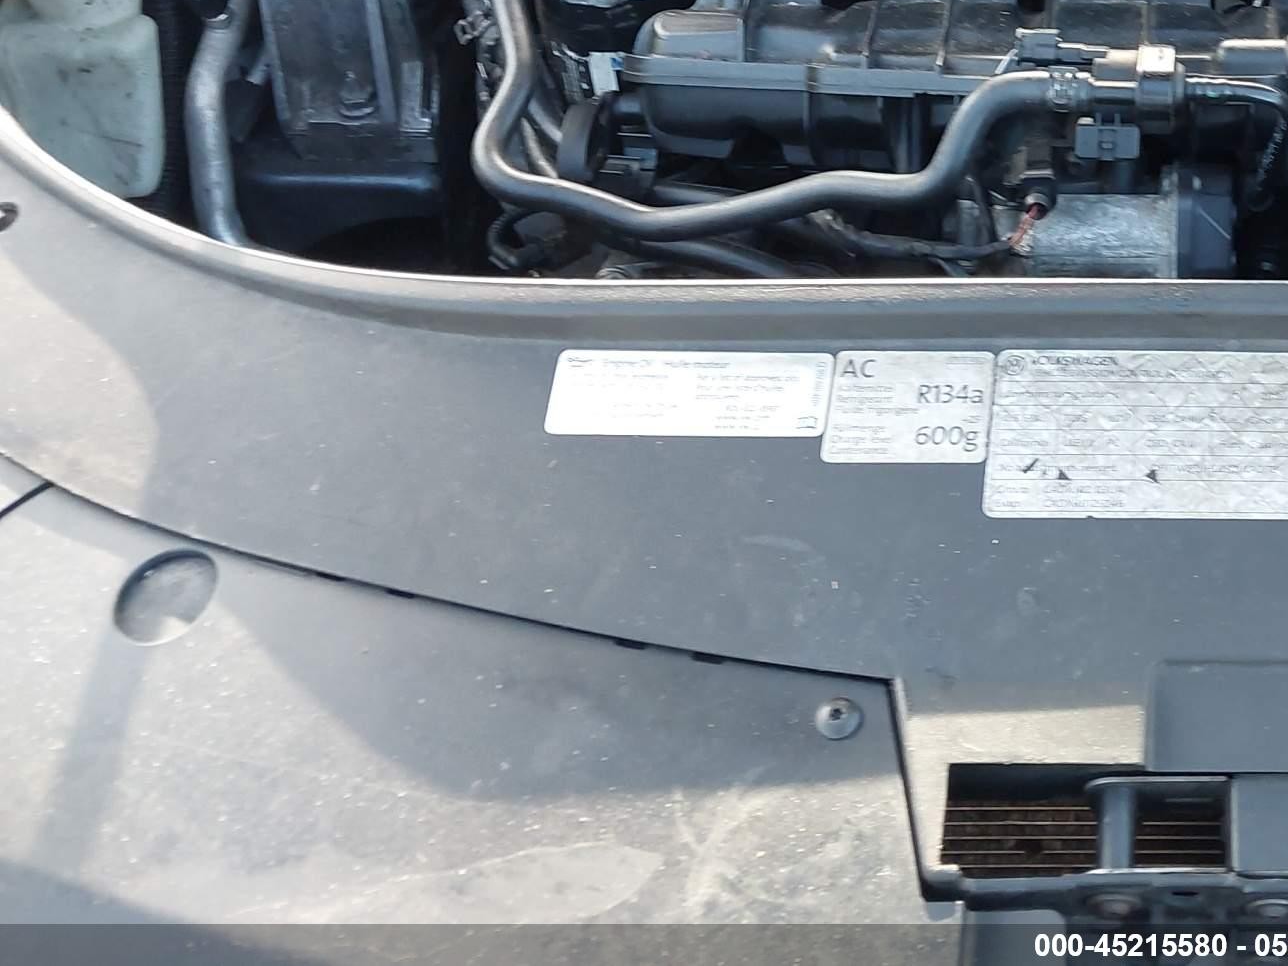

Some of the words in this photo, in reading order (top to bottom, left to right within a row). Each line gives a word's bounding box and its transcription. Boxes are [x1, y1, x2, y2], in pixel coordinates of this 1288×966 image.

[840, 359, 877, 378] AC
[917, 384, 984, 404] R134a
[915, 425, 981, 452] 600g
